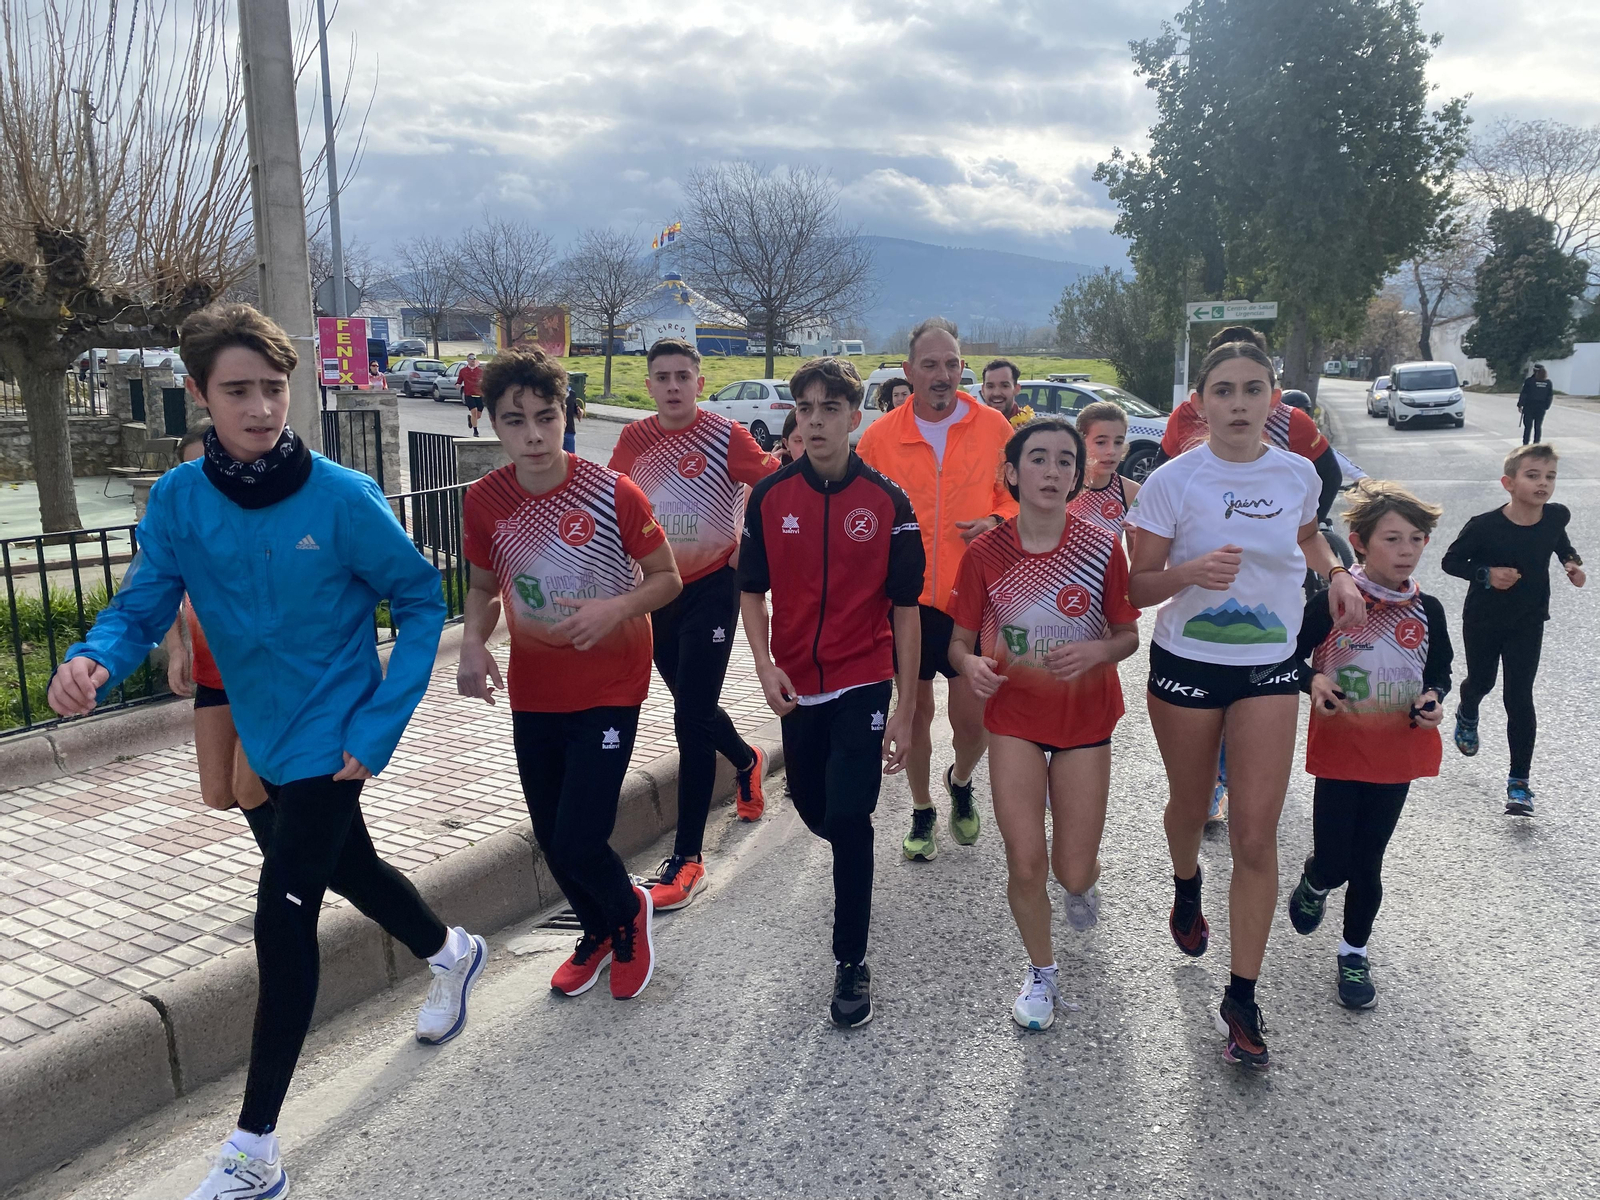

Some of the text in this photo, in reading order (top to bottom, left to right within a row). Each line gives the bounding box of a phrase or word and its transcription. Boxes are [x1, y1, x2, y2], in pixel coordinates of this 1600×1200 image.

[657, 322, 686, 334] CIRCO
[336, 319, 355, 383] FENIX
[1222, 491, 1274, 520] Jaén
[659, 513, 699, 535] ALBOR
[1151, 672, 1210, 699] NIKE
